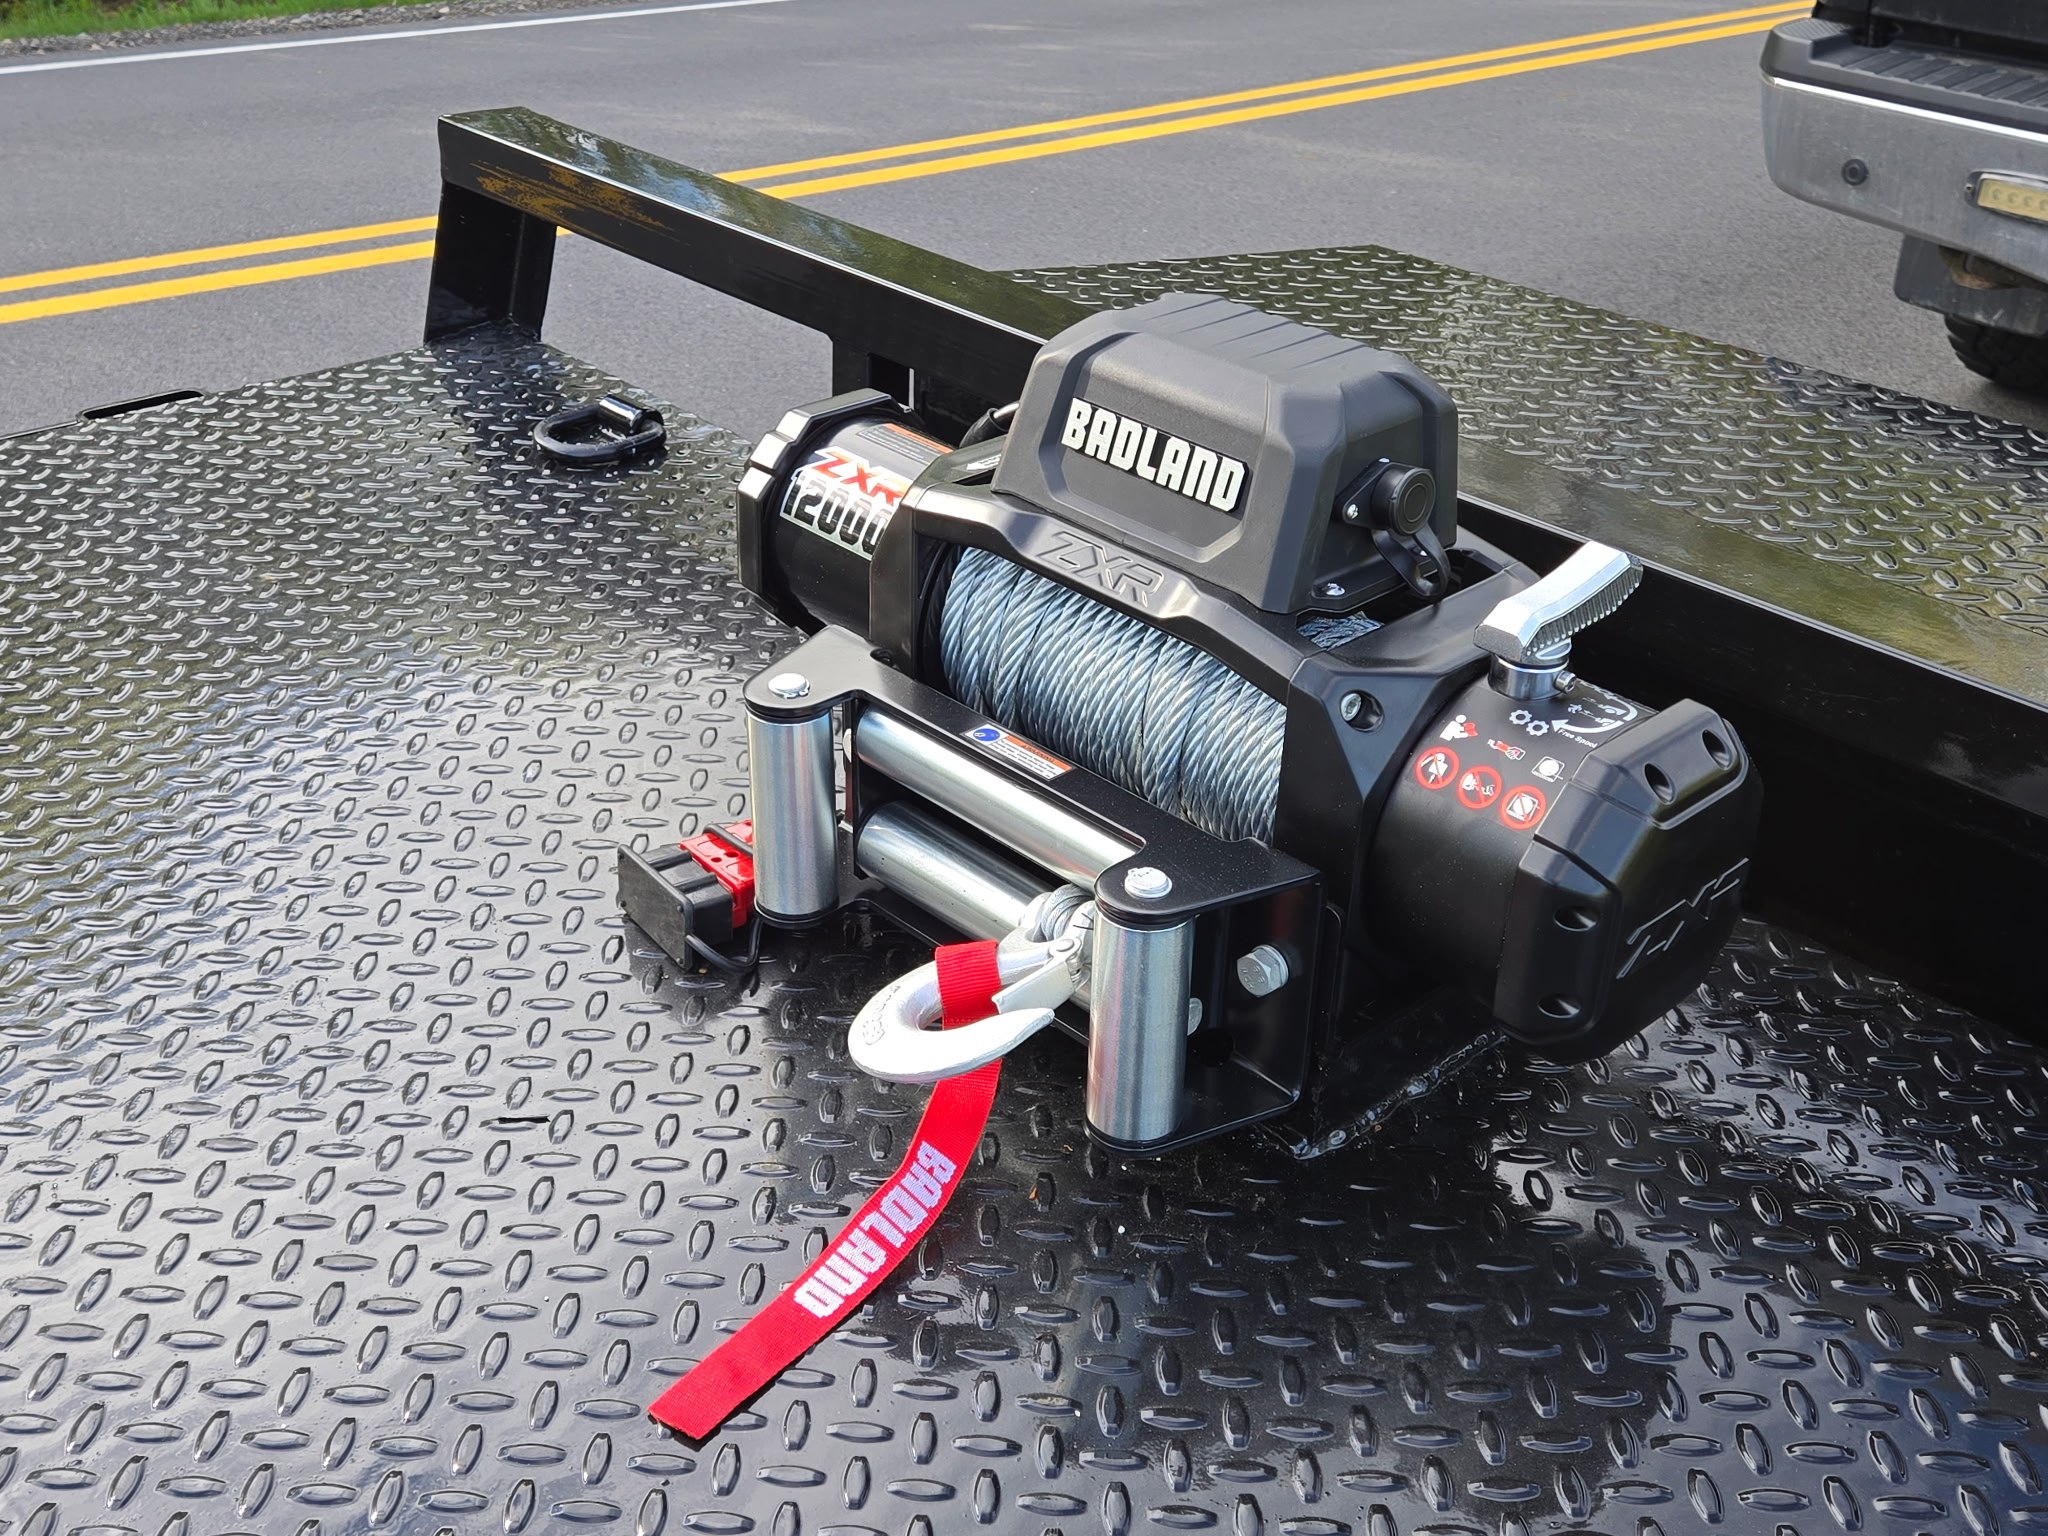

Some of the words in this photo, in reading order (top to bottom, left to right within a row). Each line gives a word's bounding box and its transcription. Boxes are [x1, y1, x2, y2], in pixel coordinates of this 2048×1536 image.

[812, 450, 910, 505] ZXR
[1061, 397, 1246, 511] BADLAND
[783, 473, 892, 554] 12000
[1036, 531, 1165, 608] ZXR
[1558, 729, 1575, 739] Free
[1575, 736, 1598, 748] Spool
[793, 1141, 958, 1318] BADLAND
